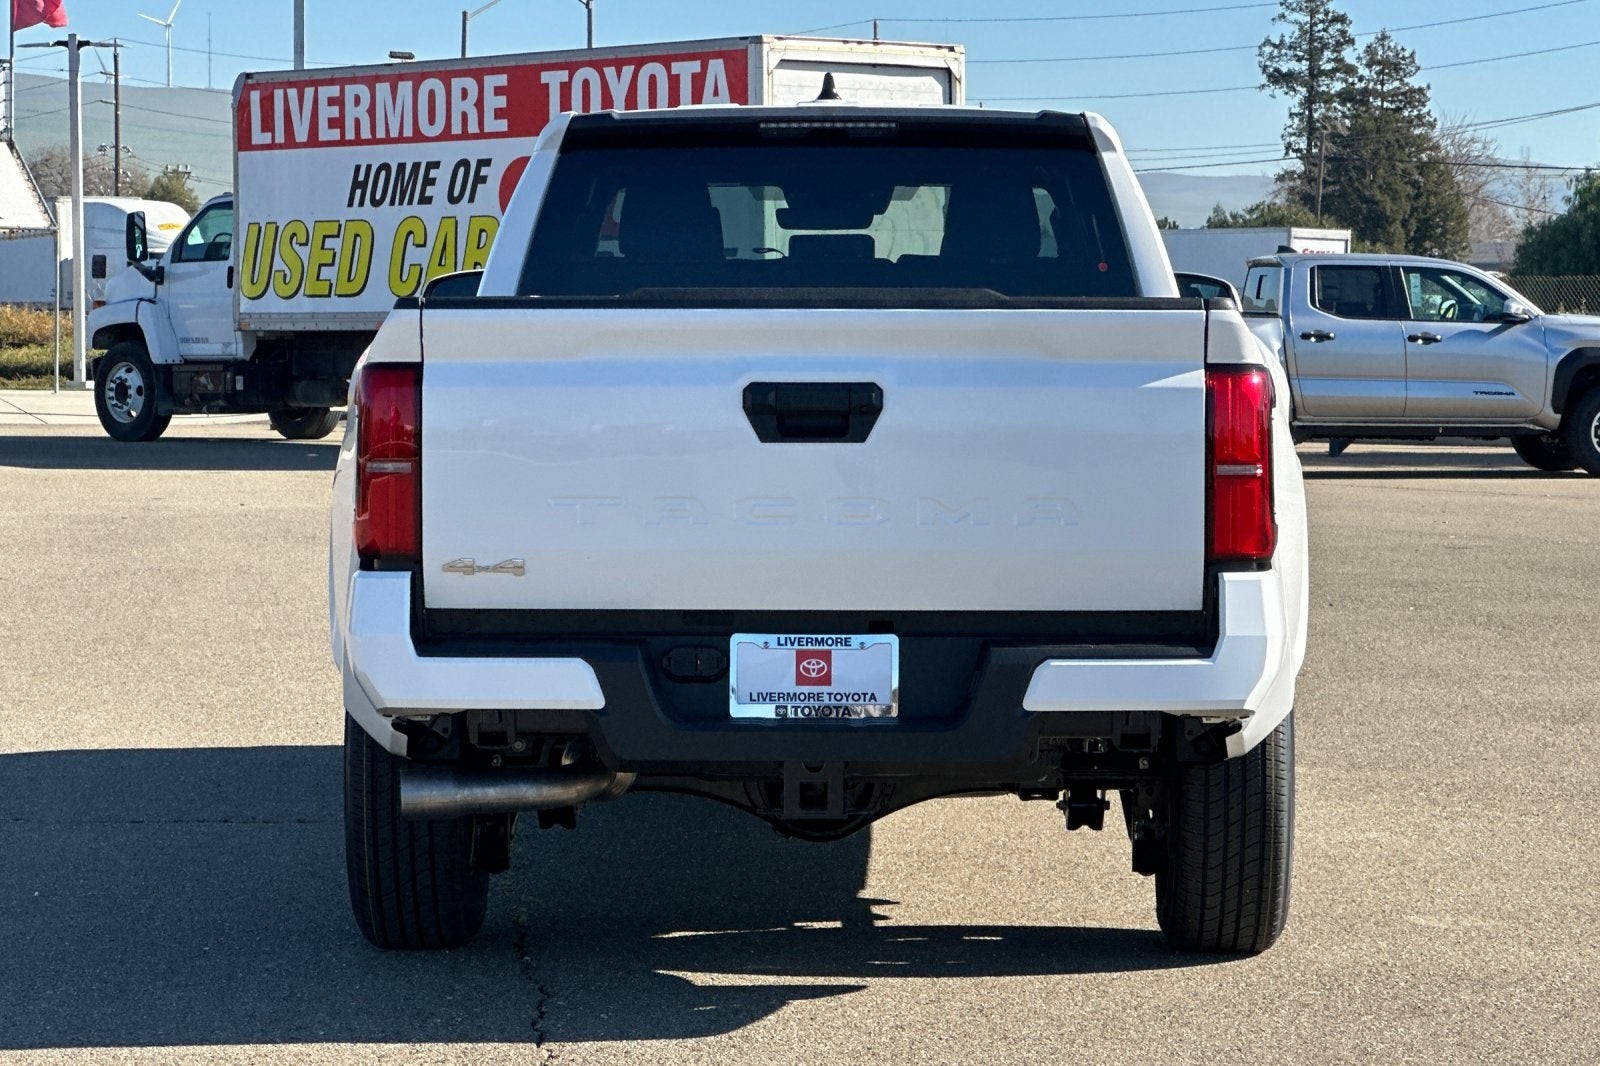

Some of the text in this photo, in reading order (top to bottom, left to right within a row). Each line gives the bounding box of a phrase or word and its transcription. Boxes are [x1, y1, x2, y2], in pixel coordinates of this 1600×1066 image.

[251, 58, 730, 145] LIVERMORE TOYOTA
[347, 158, 492, 208] HOME OF
[240, 219, 375, 300] USED
[548, 495, 1084, 527] TACOMA
[777, 636, 852, 647] LIVERMORE
[749, 692, 878, 703] LIVERMORE TOYOTA
[792, 705, 852, 717] TOYOTA
